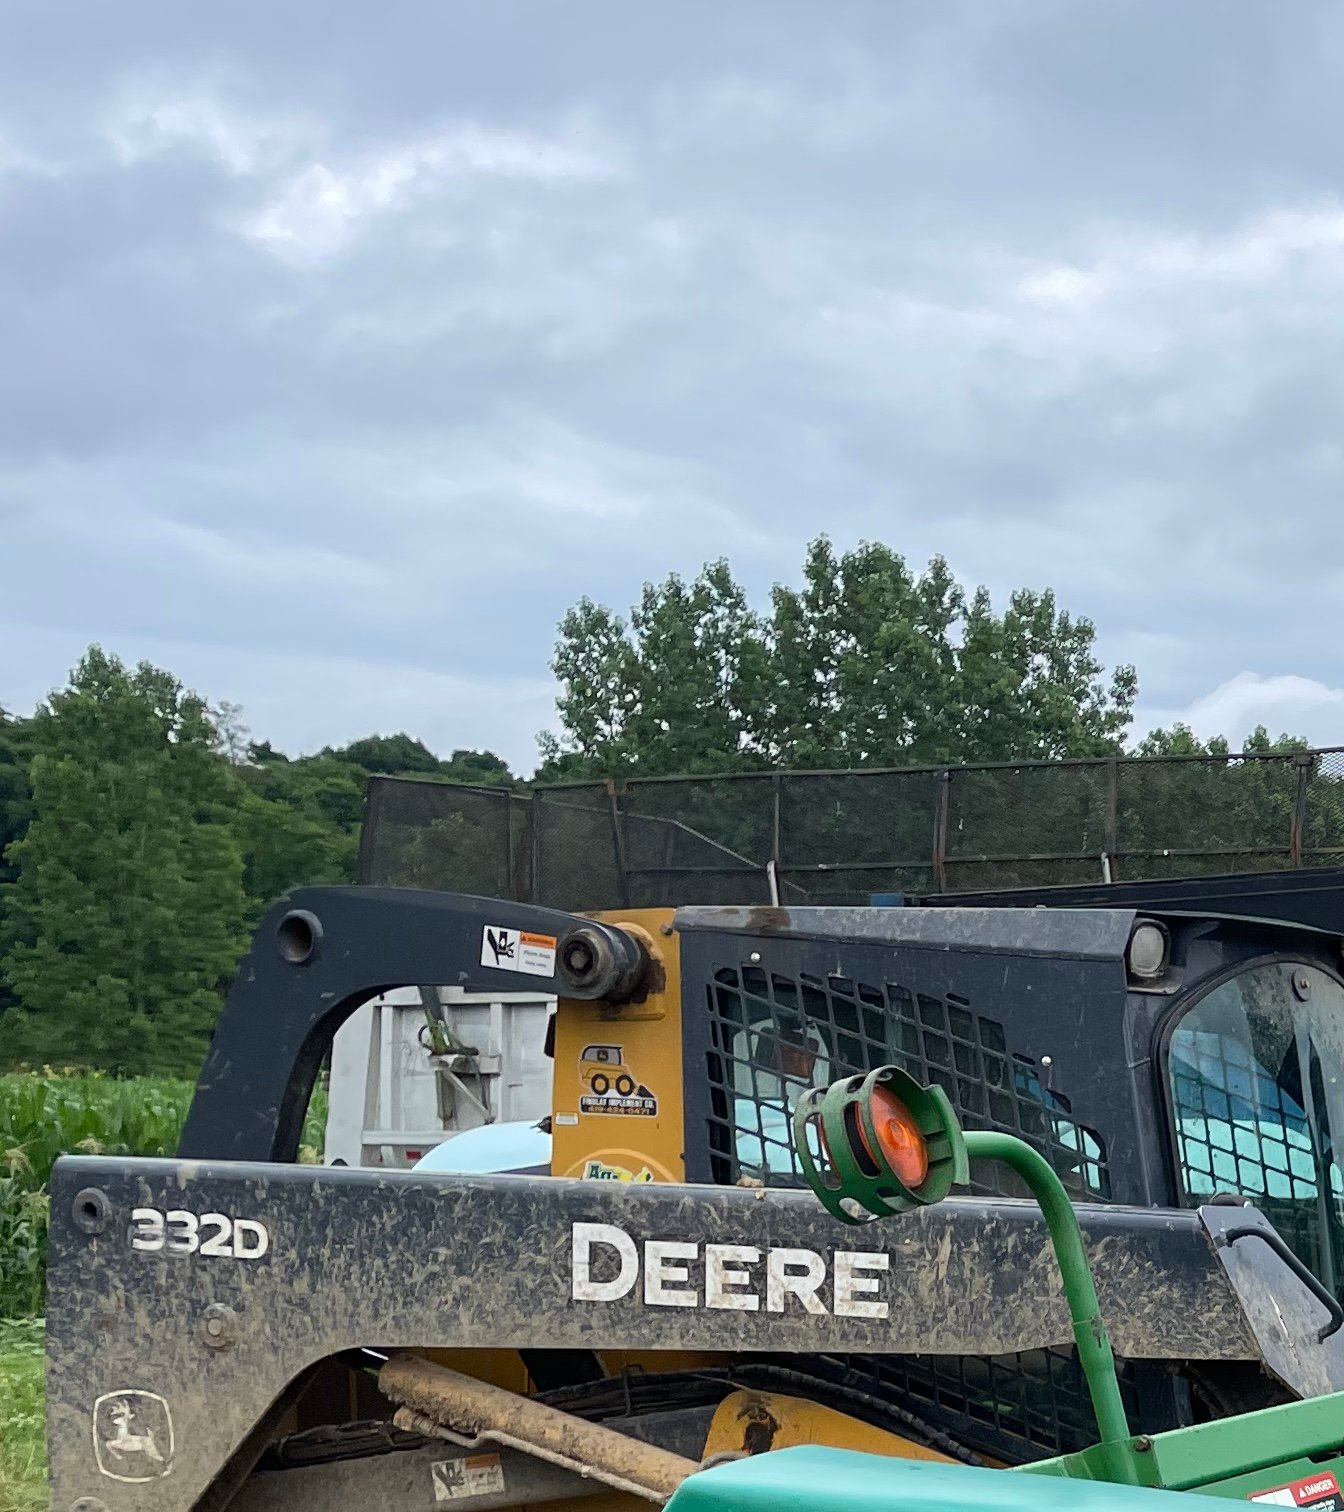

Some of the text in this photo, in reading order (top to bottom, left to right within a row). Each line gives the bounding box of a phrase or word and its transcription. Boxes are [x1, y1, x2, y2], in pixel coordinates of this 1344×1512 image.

[131, 1207, 269, 1259] 332D
[572, 1221, 890, 1319] DEERE
[1304, 1478, 1335, 1497] DANGER
